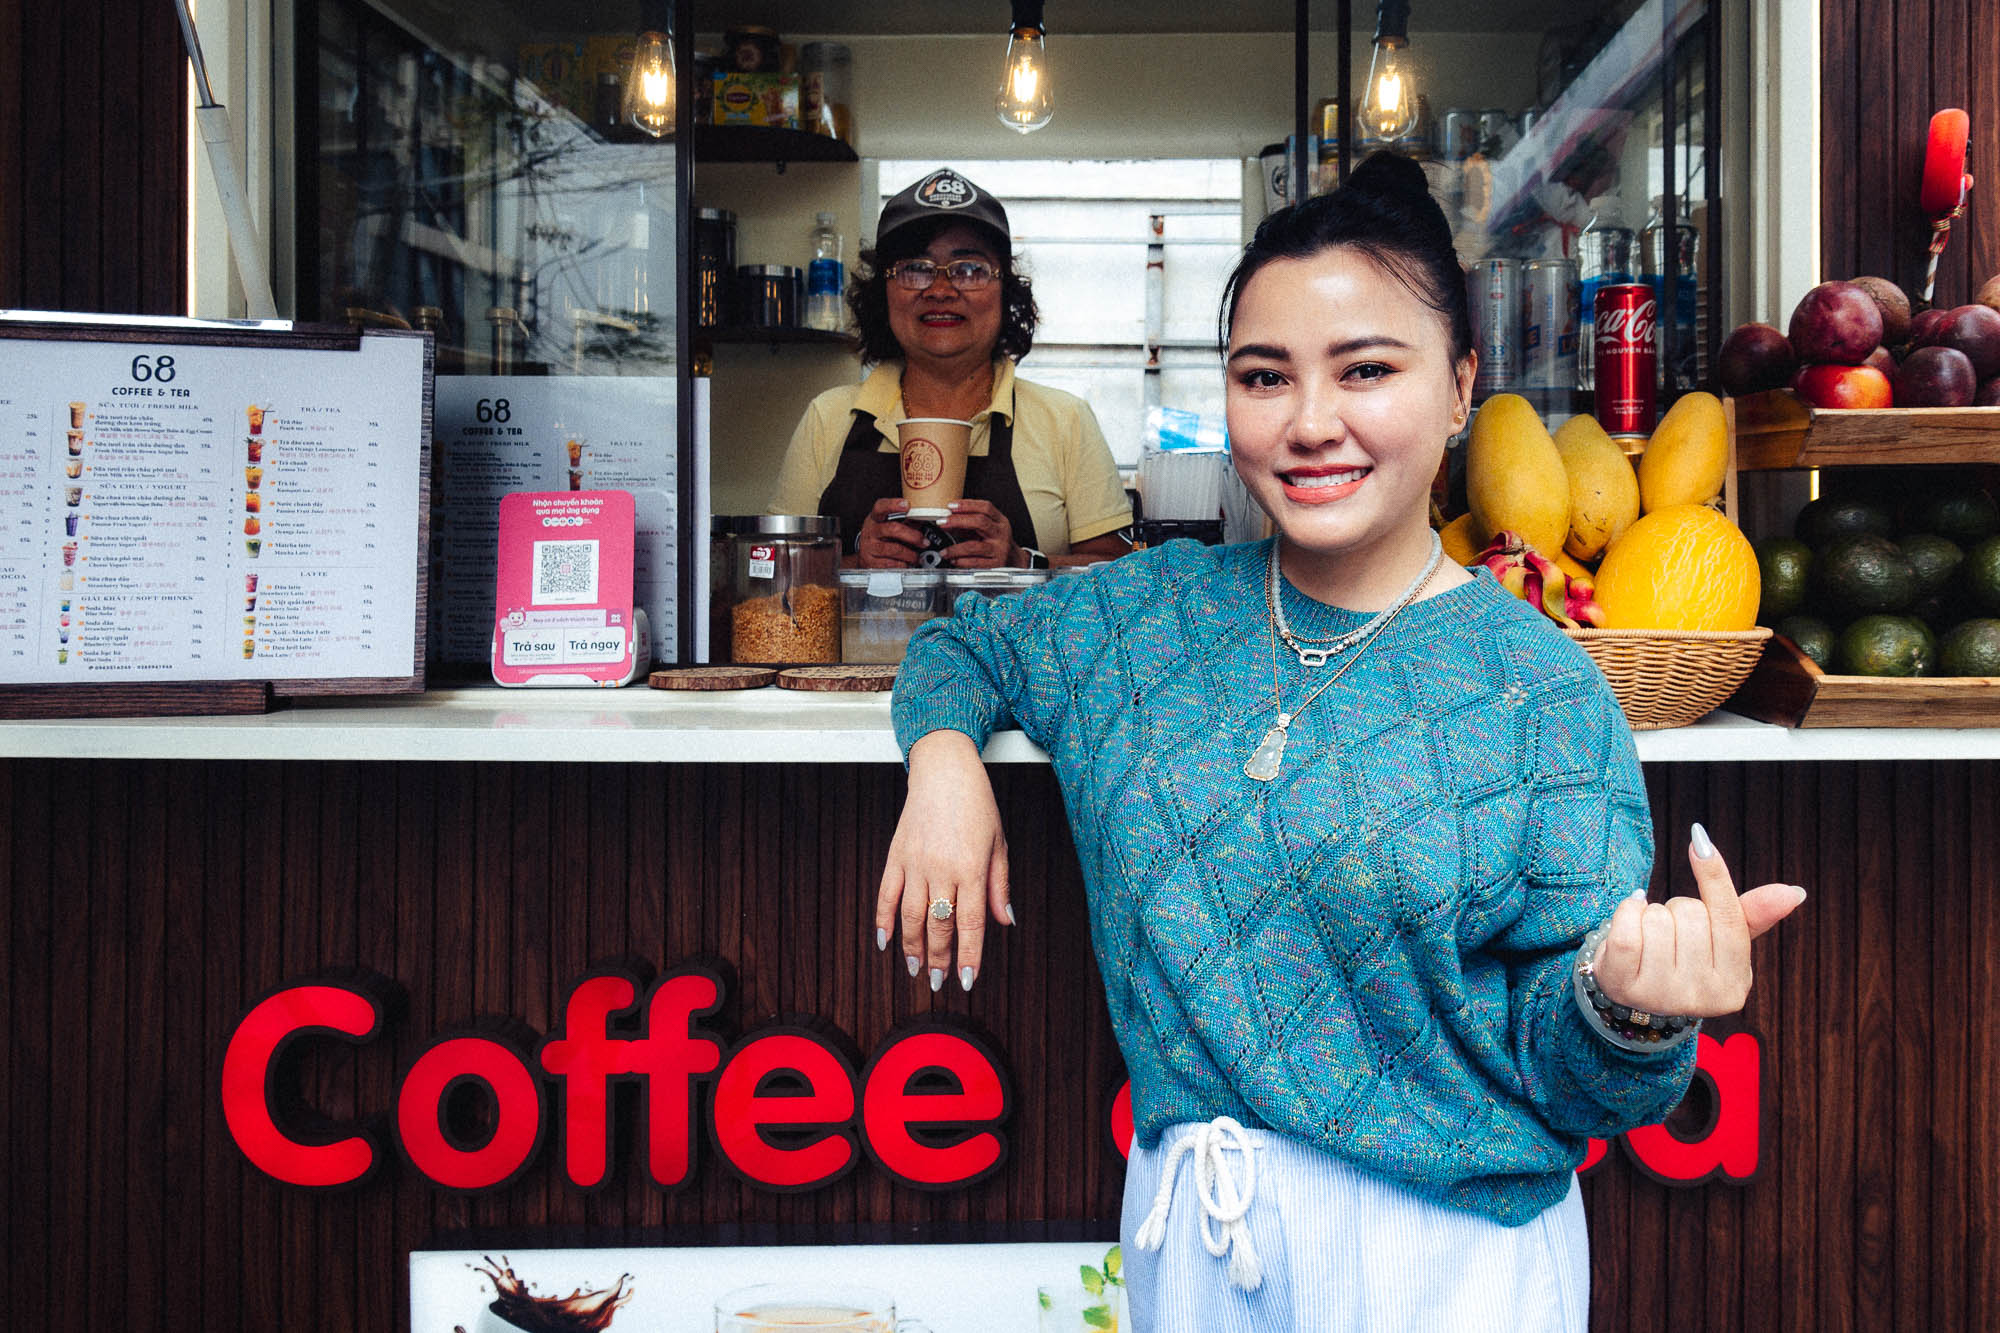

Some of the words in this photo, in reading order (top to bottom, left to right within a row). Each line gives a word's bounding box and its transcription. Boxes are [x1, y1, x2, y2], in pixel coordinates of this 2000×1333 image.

[936, 180, 966, 194] 68
[132, 355, 176, 382] 68
[112, 387, 152, 396] COFFEE
[171, 389, 190, 397] TEA
[476, 399, 511, 423] 68
[533, 499, 552, 507] Nhận
[581, 507, 600, 515] dụng
[513, 641, 531, 651] Trả
[534, 642, 555, 651] sau
[569, 640, 587, 650] Trả
[591, 641, 620, 650] ngay
[222, 974, 1003, 1187] Coffee
